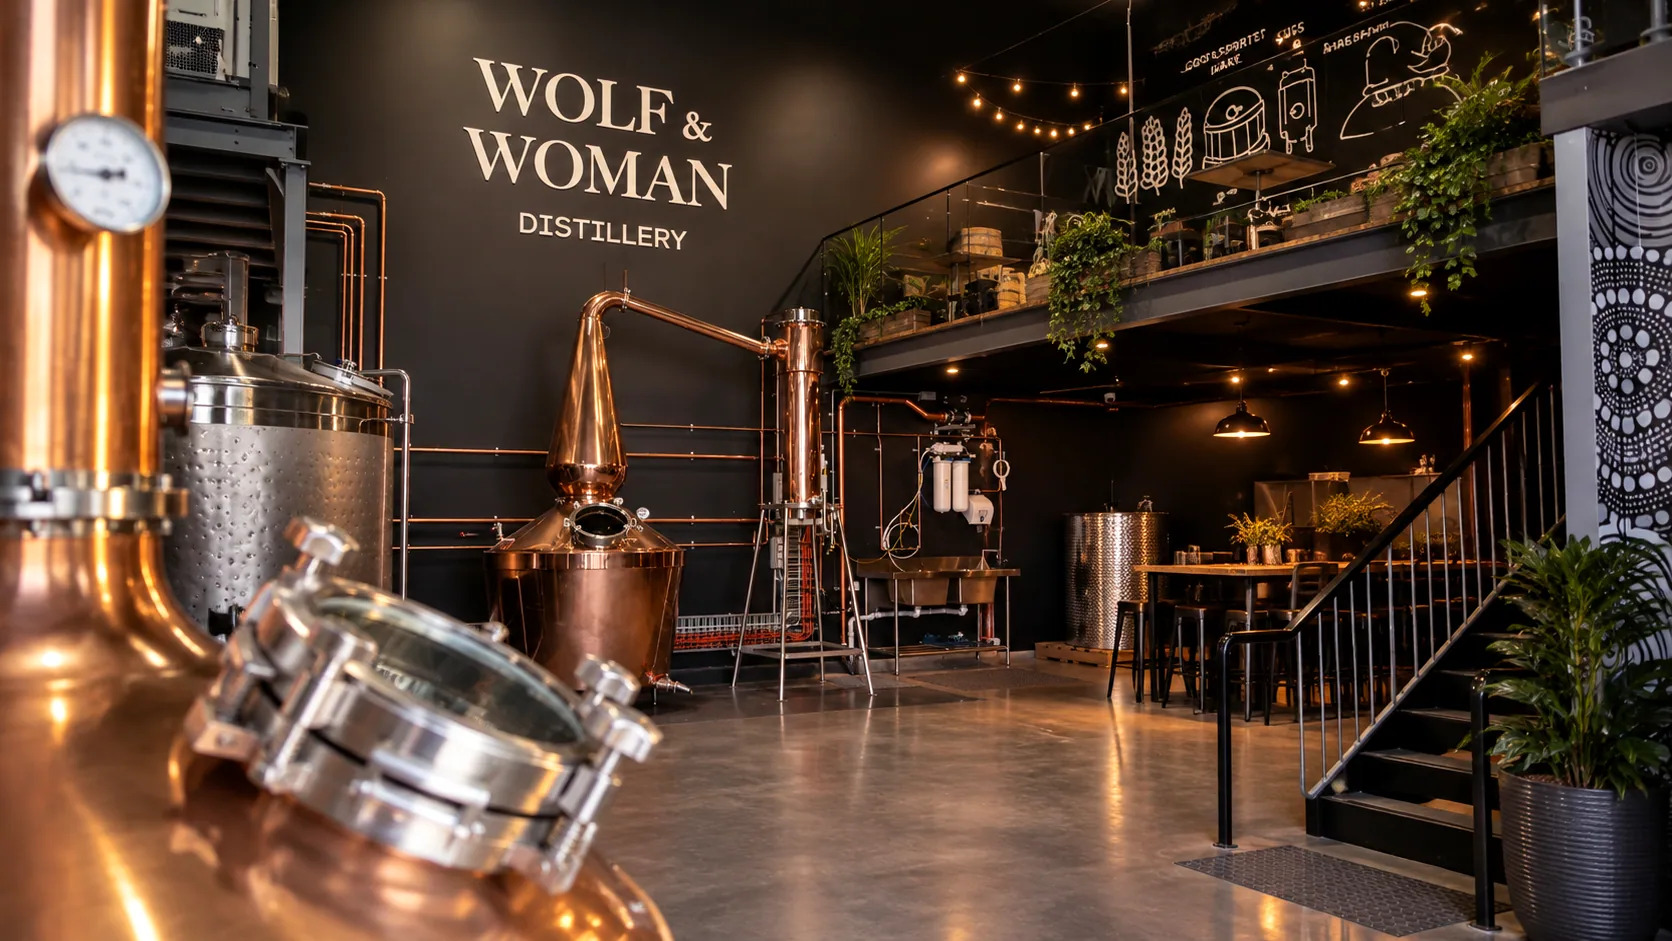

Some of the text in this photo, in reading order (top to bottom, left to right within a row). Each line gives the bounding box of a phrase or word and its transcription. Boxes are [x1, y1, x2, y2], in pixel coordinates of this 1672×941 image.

[473, 57, 713, 142] WOLF &
[462, 126, 733, 210] WOMAN
[519, 211, 688, 251] DISTILLERY
